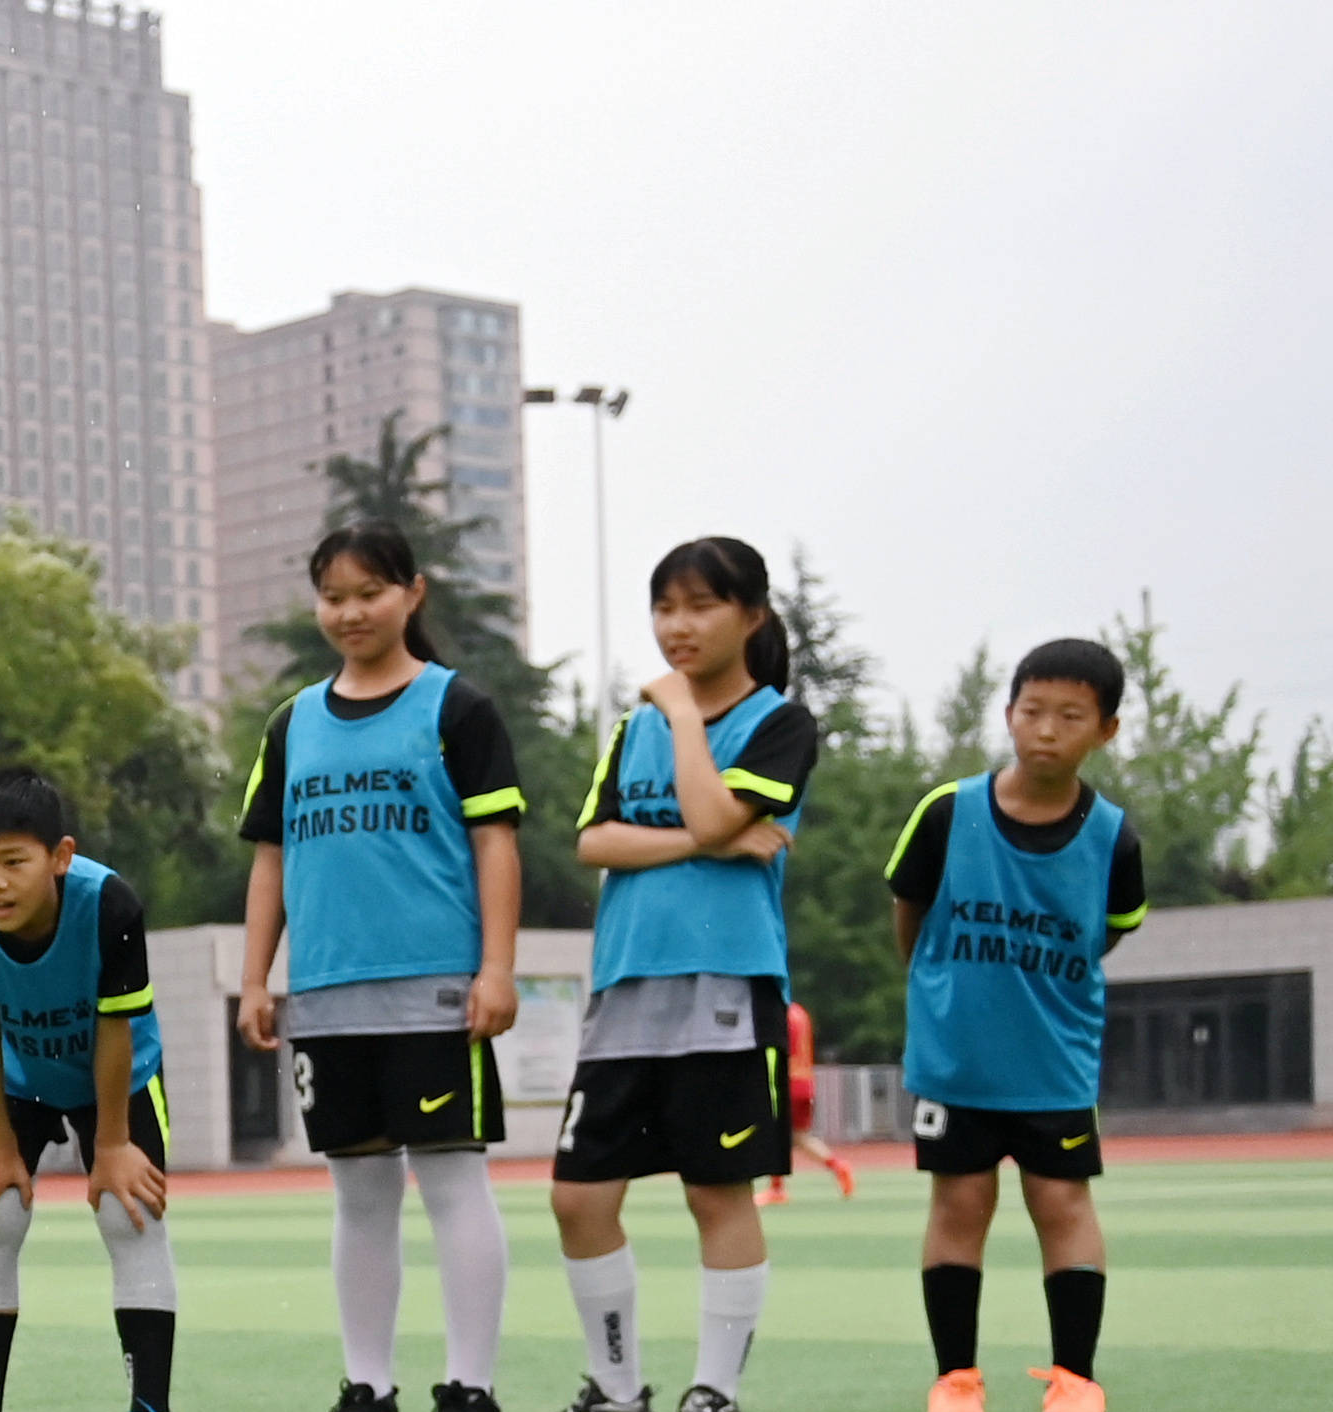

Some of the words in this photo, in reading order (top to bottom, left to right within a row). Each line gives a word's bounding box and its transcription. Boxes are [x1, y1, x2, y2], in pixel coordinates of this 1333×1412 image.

[292, 770, 390, 803] KELME
[951, 901, 1055, 938] KELME
[953, 934, 1088, 982] AMUNG
